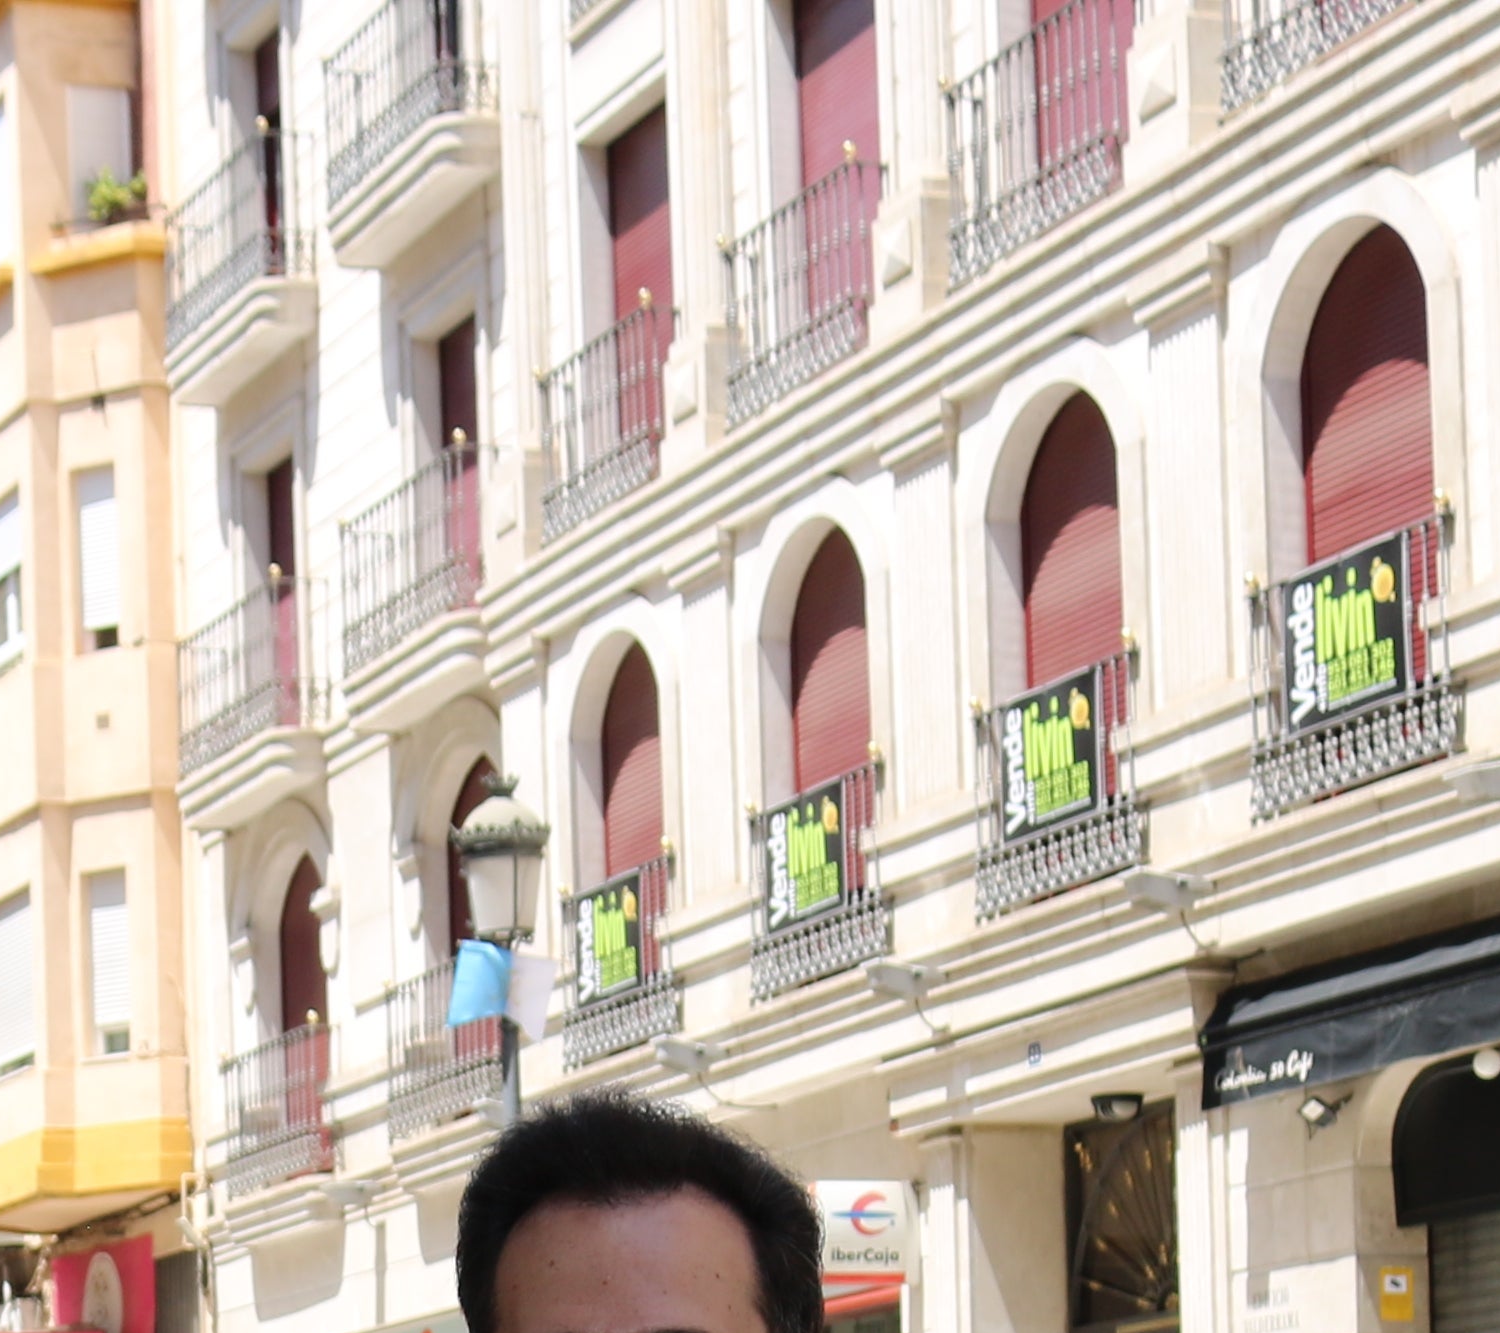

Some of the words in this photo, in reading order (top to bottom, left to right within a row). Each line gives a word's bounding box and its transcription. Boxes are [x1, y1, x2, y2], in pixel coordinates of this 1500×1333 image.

[1287, 582, 1316, 724] Vende
[1315, 567, 1375, 663] livin
[1003, 708, 1026, 834] Vende
[1023, 695, 1074, 780] livin
[767, 812, 788, 928] Vende
[788, 802, 826, 878] livin
[577, 898, 594, 1004] Vende
[594, 891, 626, 961] livin
[829, 1249, 900, 1264] iberCaja
